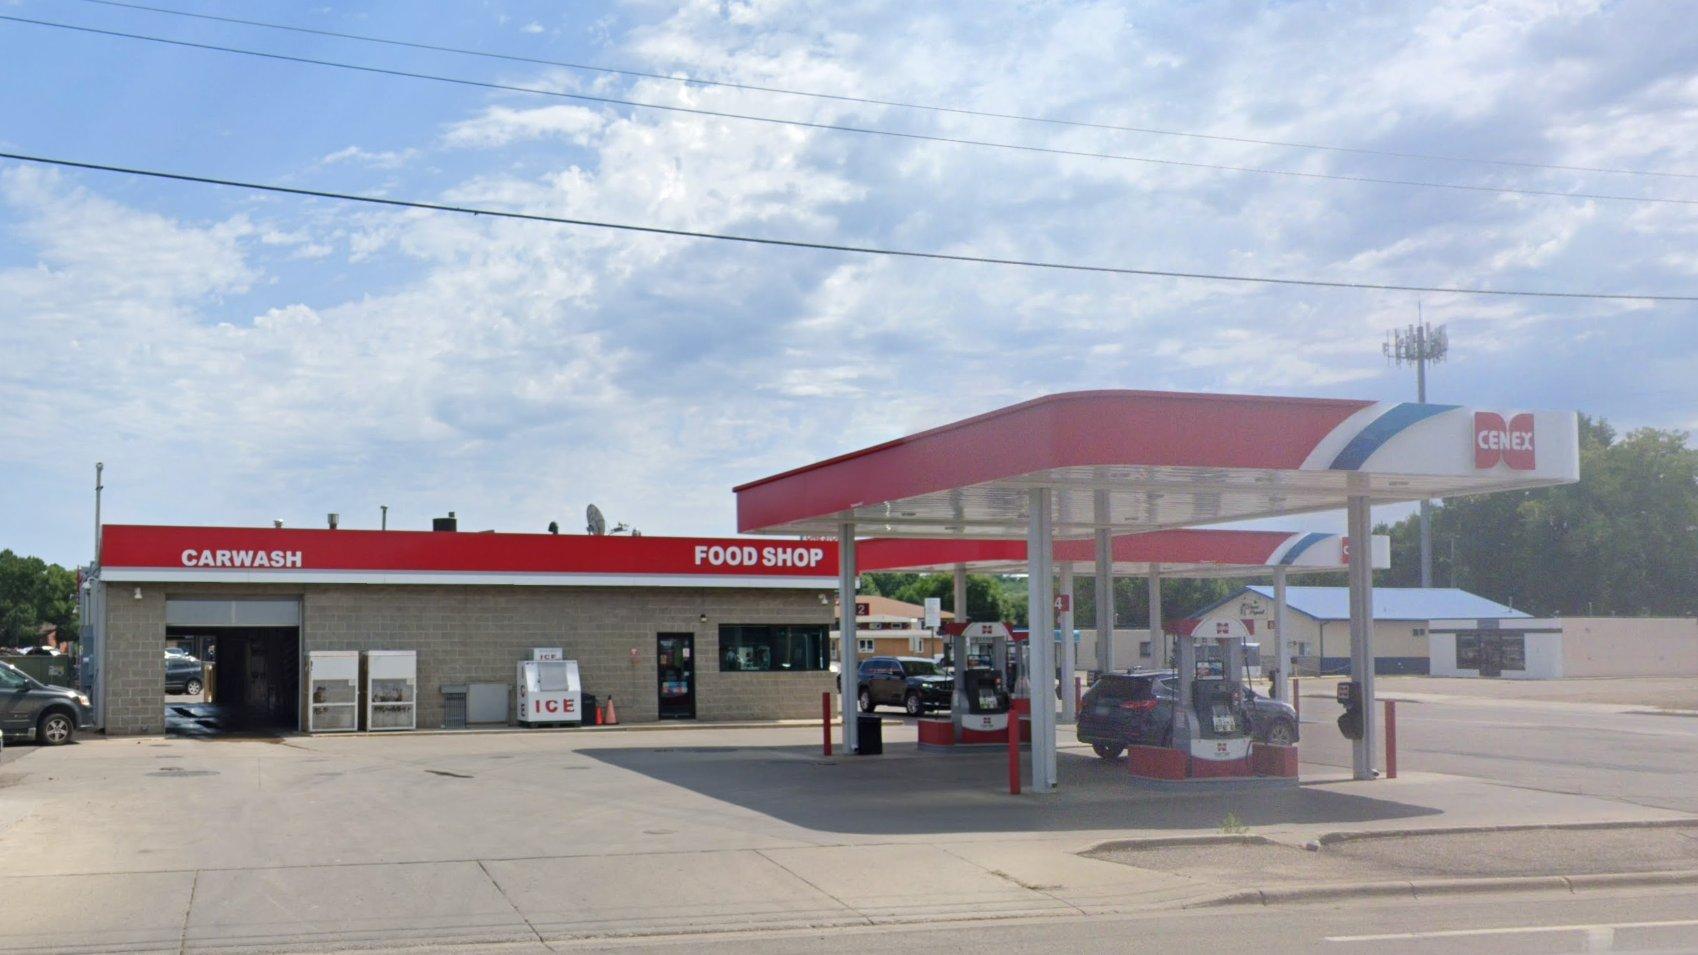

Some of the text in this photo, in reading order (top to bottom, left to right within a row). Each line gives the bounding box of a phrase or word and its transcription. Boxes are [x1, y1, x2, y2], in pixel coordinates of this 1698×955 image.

[1478, 430, 1533, 451] CENEX
[181, 549, 302, 567] CARWASH
[695, 546, 823, 567] FOOD SHOP
[858, 605, 865, 615] 2
[535, 699, 575, 713] ICE
